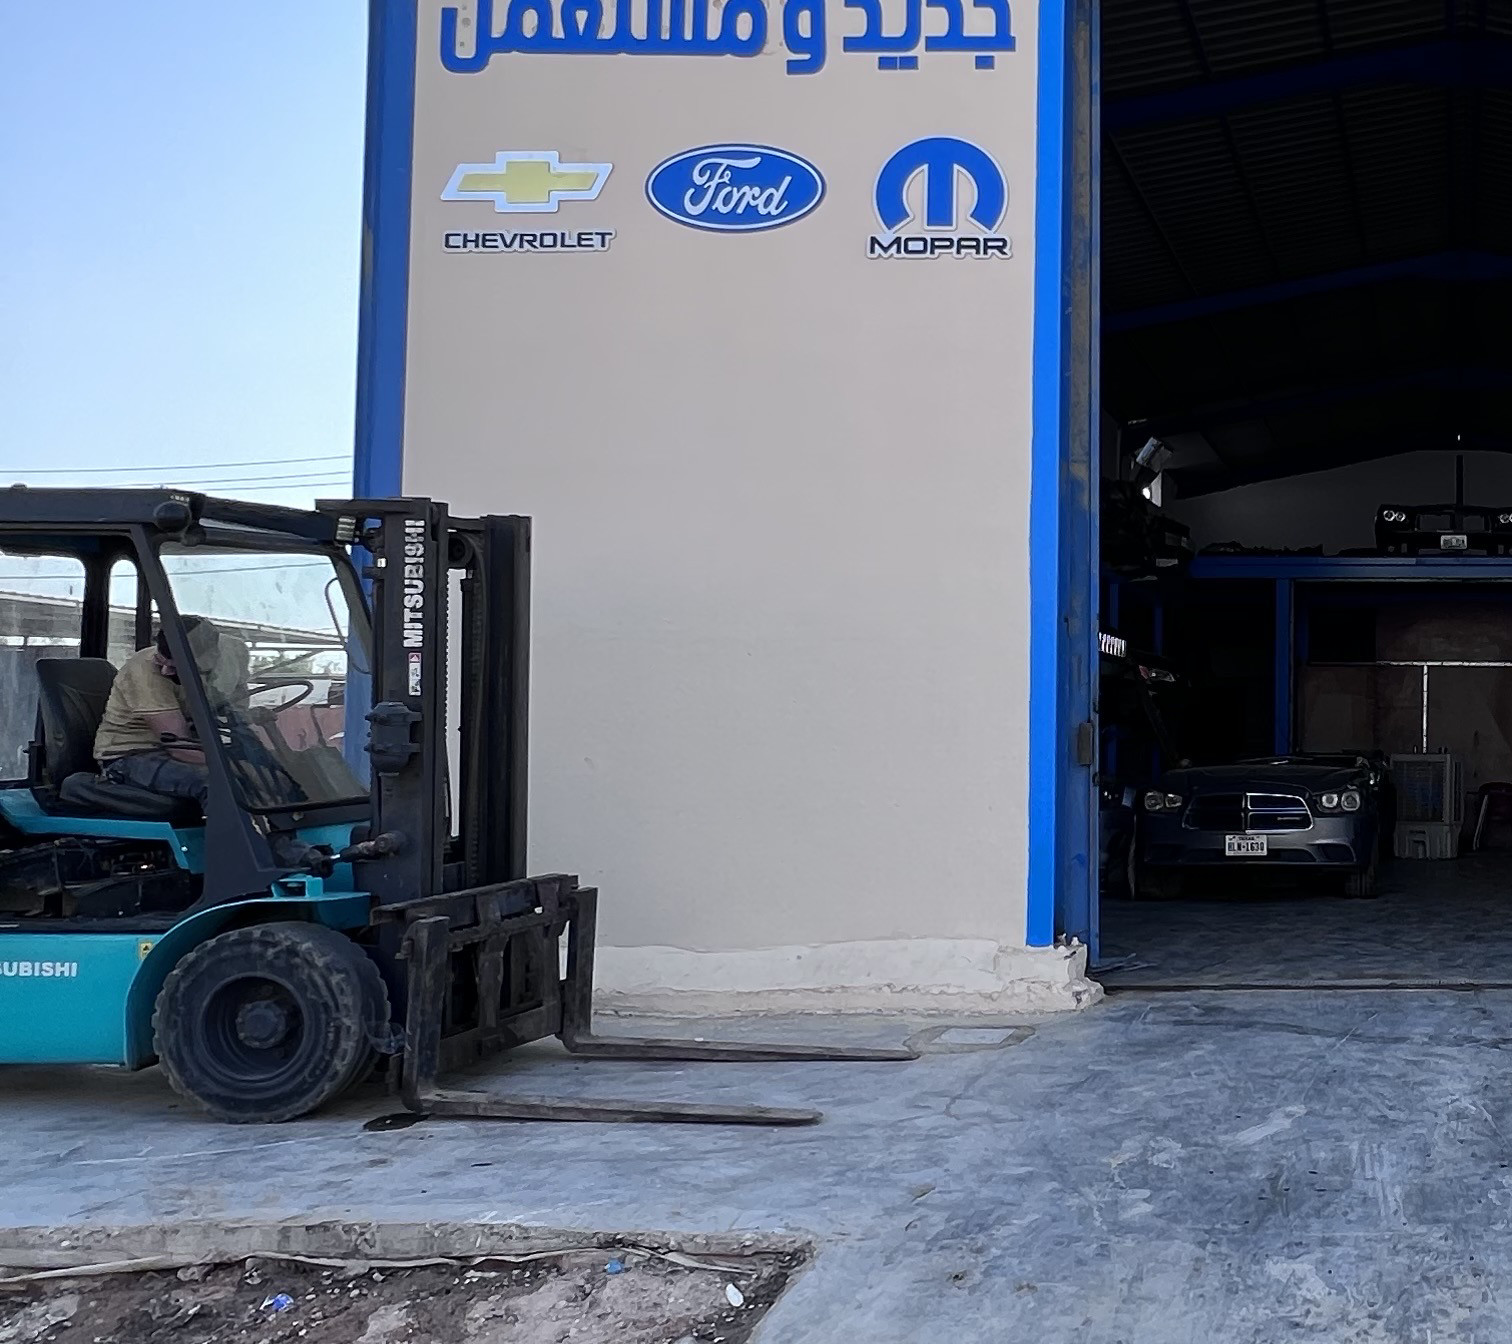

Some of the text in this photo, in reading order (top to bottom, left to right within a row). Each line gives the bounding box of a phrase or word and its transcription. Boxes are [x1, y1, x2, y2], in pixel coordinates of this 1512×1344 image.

[684, 156, 793, 216] Ford
[444, 231, 613, 250] CHEVROLET
[869, 236, 1009, 256] MOPAR
[403, 519, 426, 648] MITSUBISHI
[0, 961, 78, 977] UBISHI
